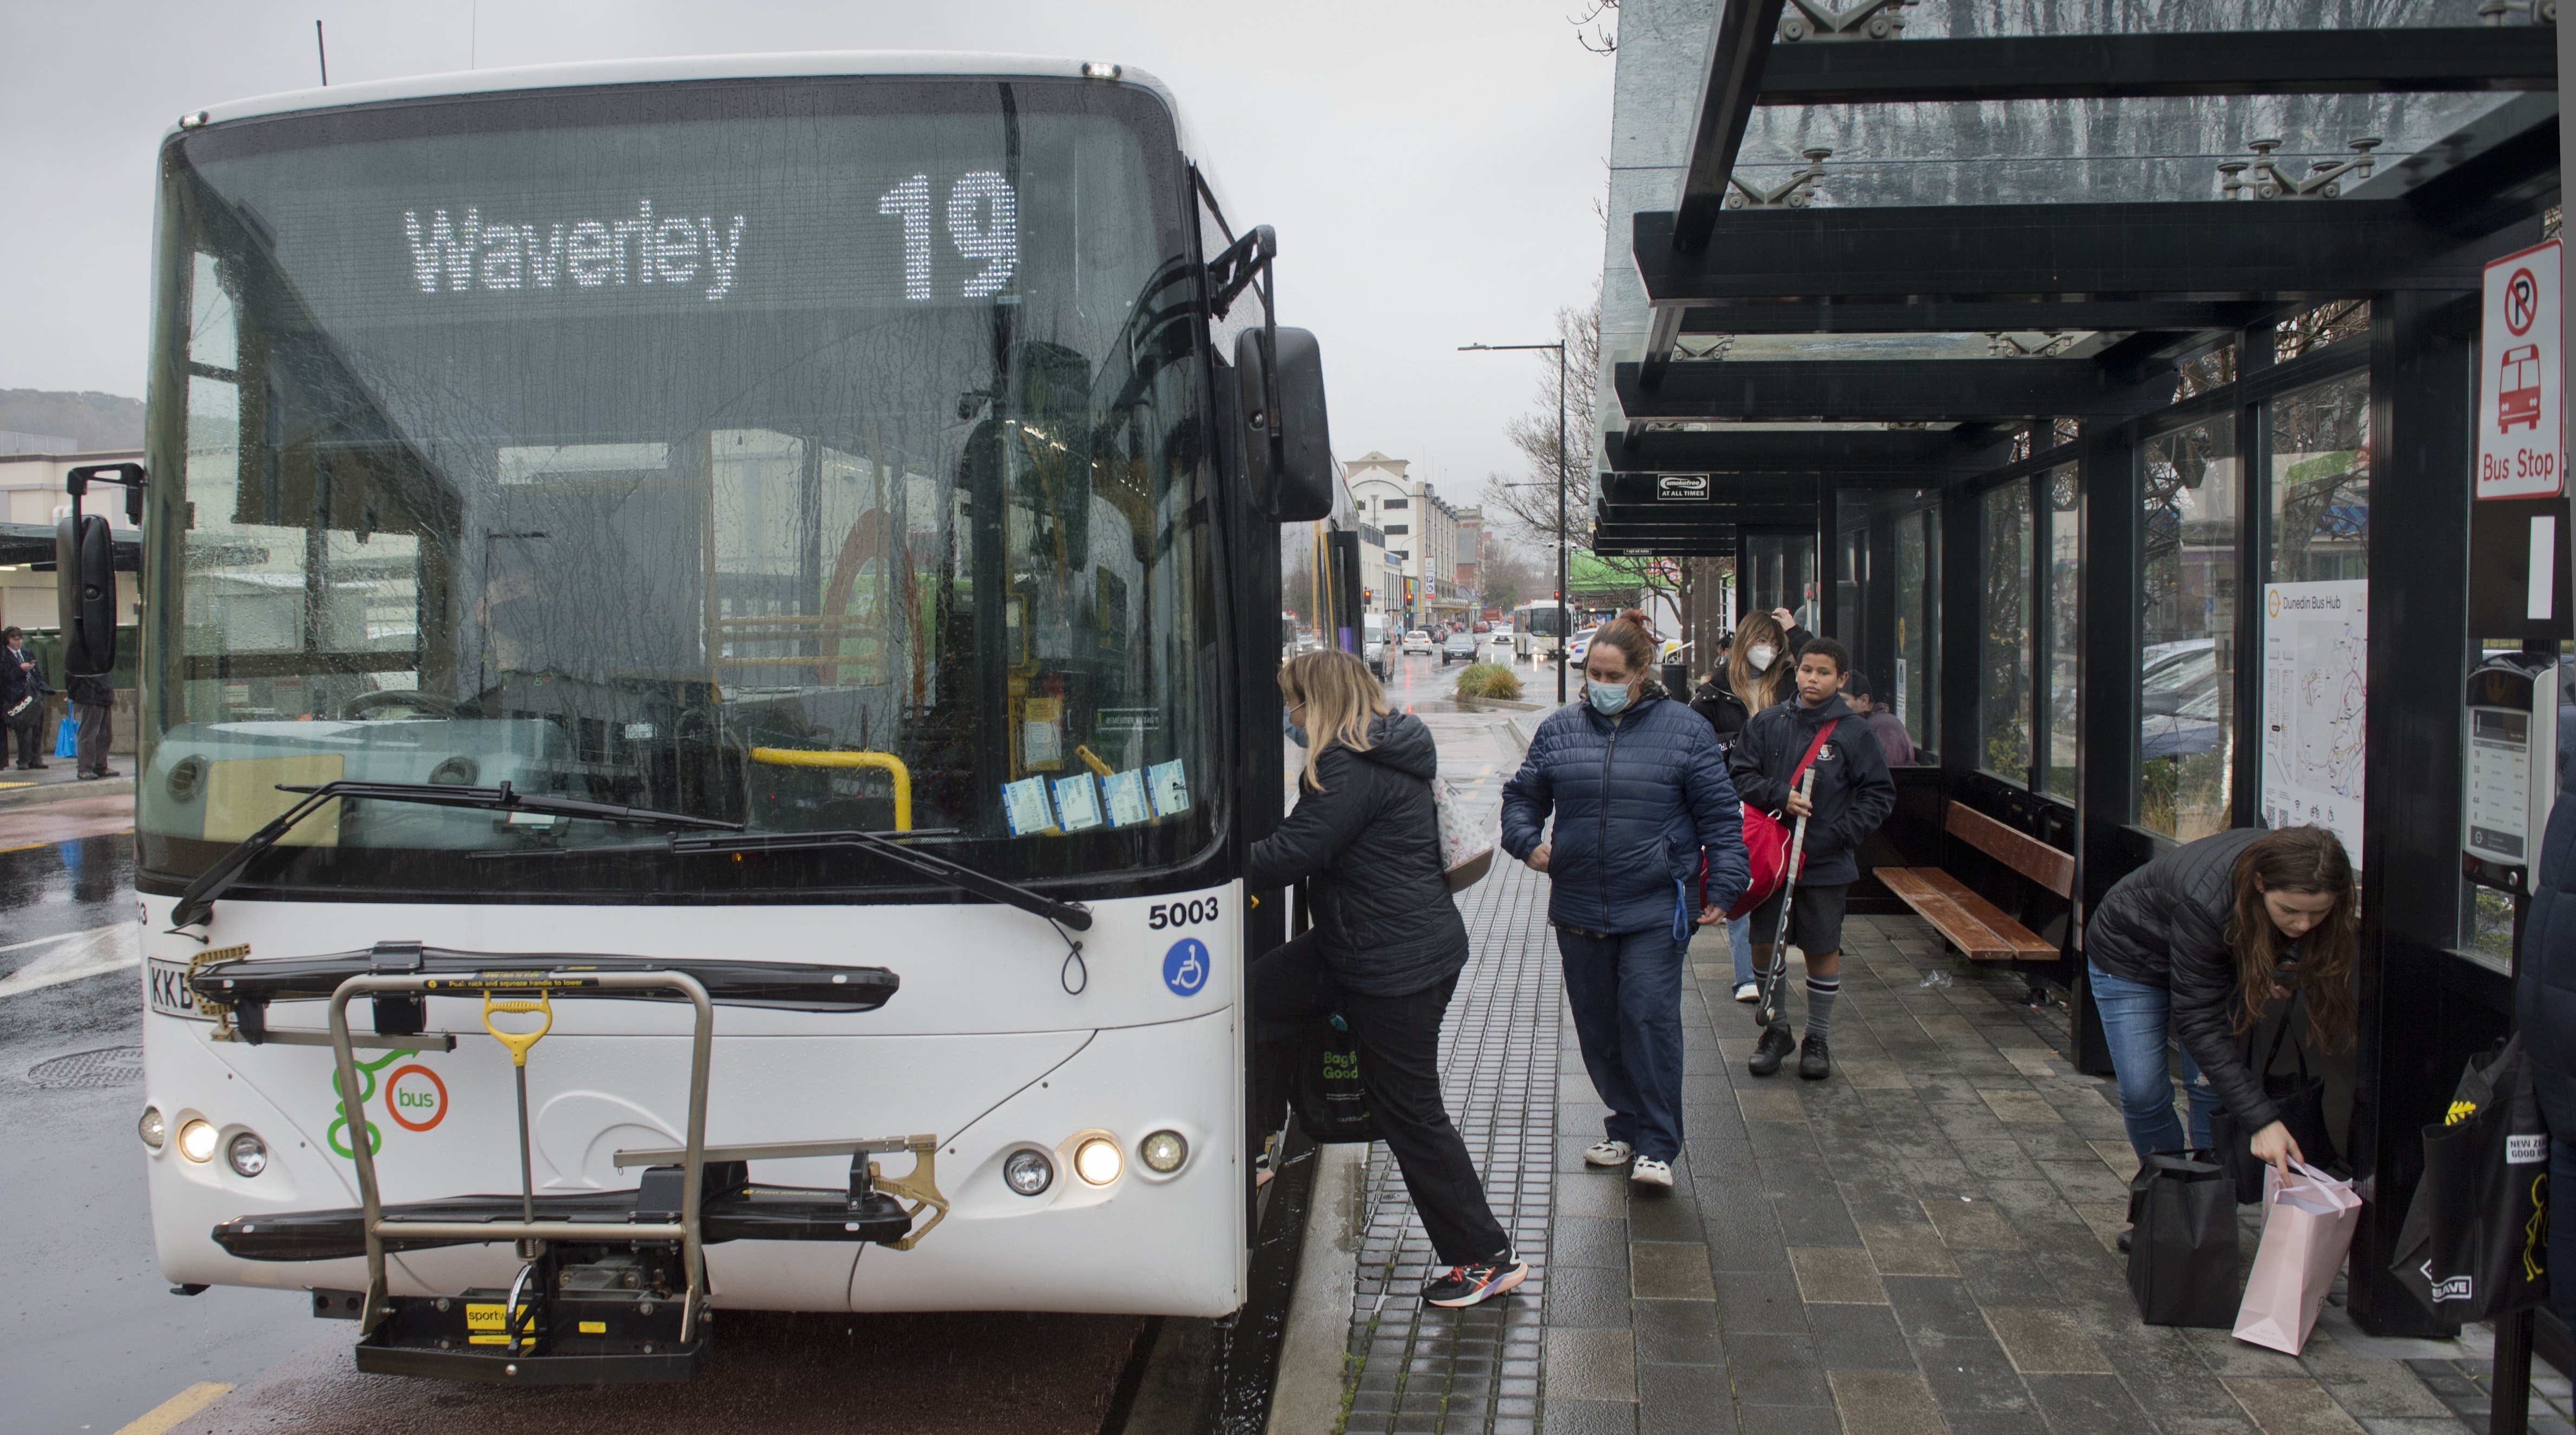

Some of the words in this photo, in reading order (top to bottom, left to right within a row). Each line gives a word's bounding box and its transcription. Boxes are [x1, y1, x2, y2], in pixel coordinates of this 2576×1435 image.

[404, 198, 746, 302] Waverley
[878, 169, 1020, 301] 19
[2483, 453, 2509, 482] Bus
[2516, 448, 2554, 481] Stop
[2283, 597, 2310, 609] Dunedin
[2312, 596, 2324, 609] Bus
[2326, 595, 2341, 609] Hub
[8, 696, 32, 716] adidas
[1148, 897, 1219, 930] 5003
[152, 967, 193, 1009] KKB
[1324, 1051, 1349, 1068] Bag
[1323, 1066, 1358, 1079] Good
[399, 1087, 434, 1108] bus
[2432, 1281, 2467, 1298] SAVE
